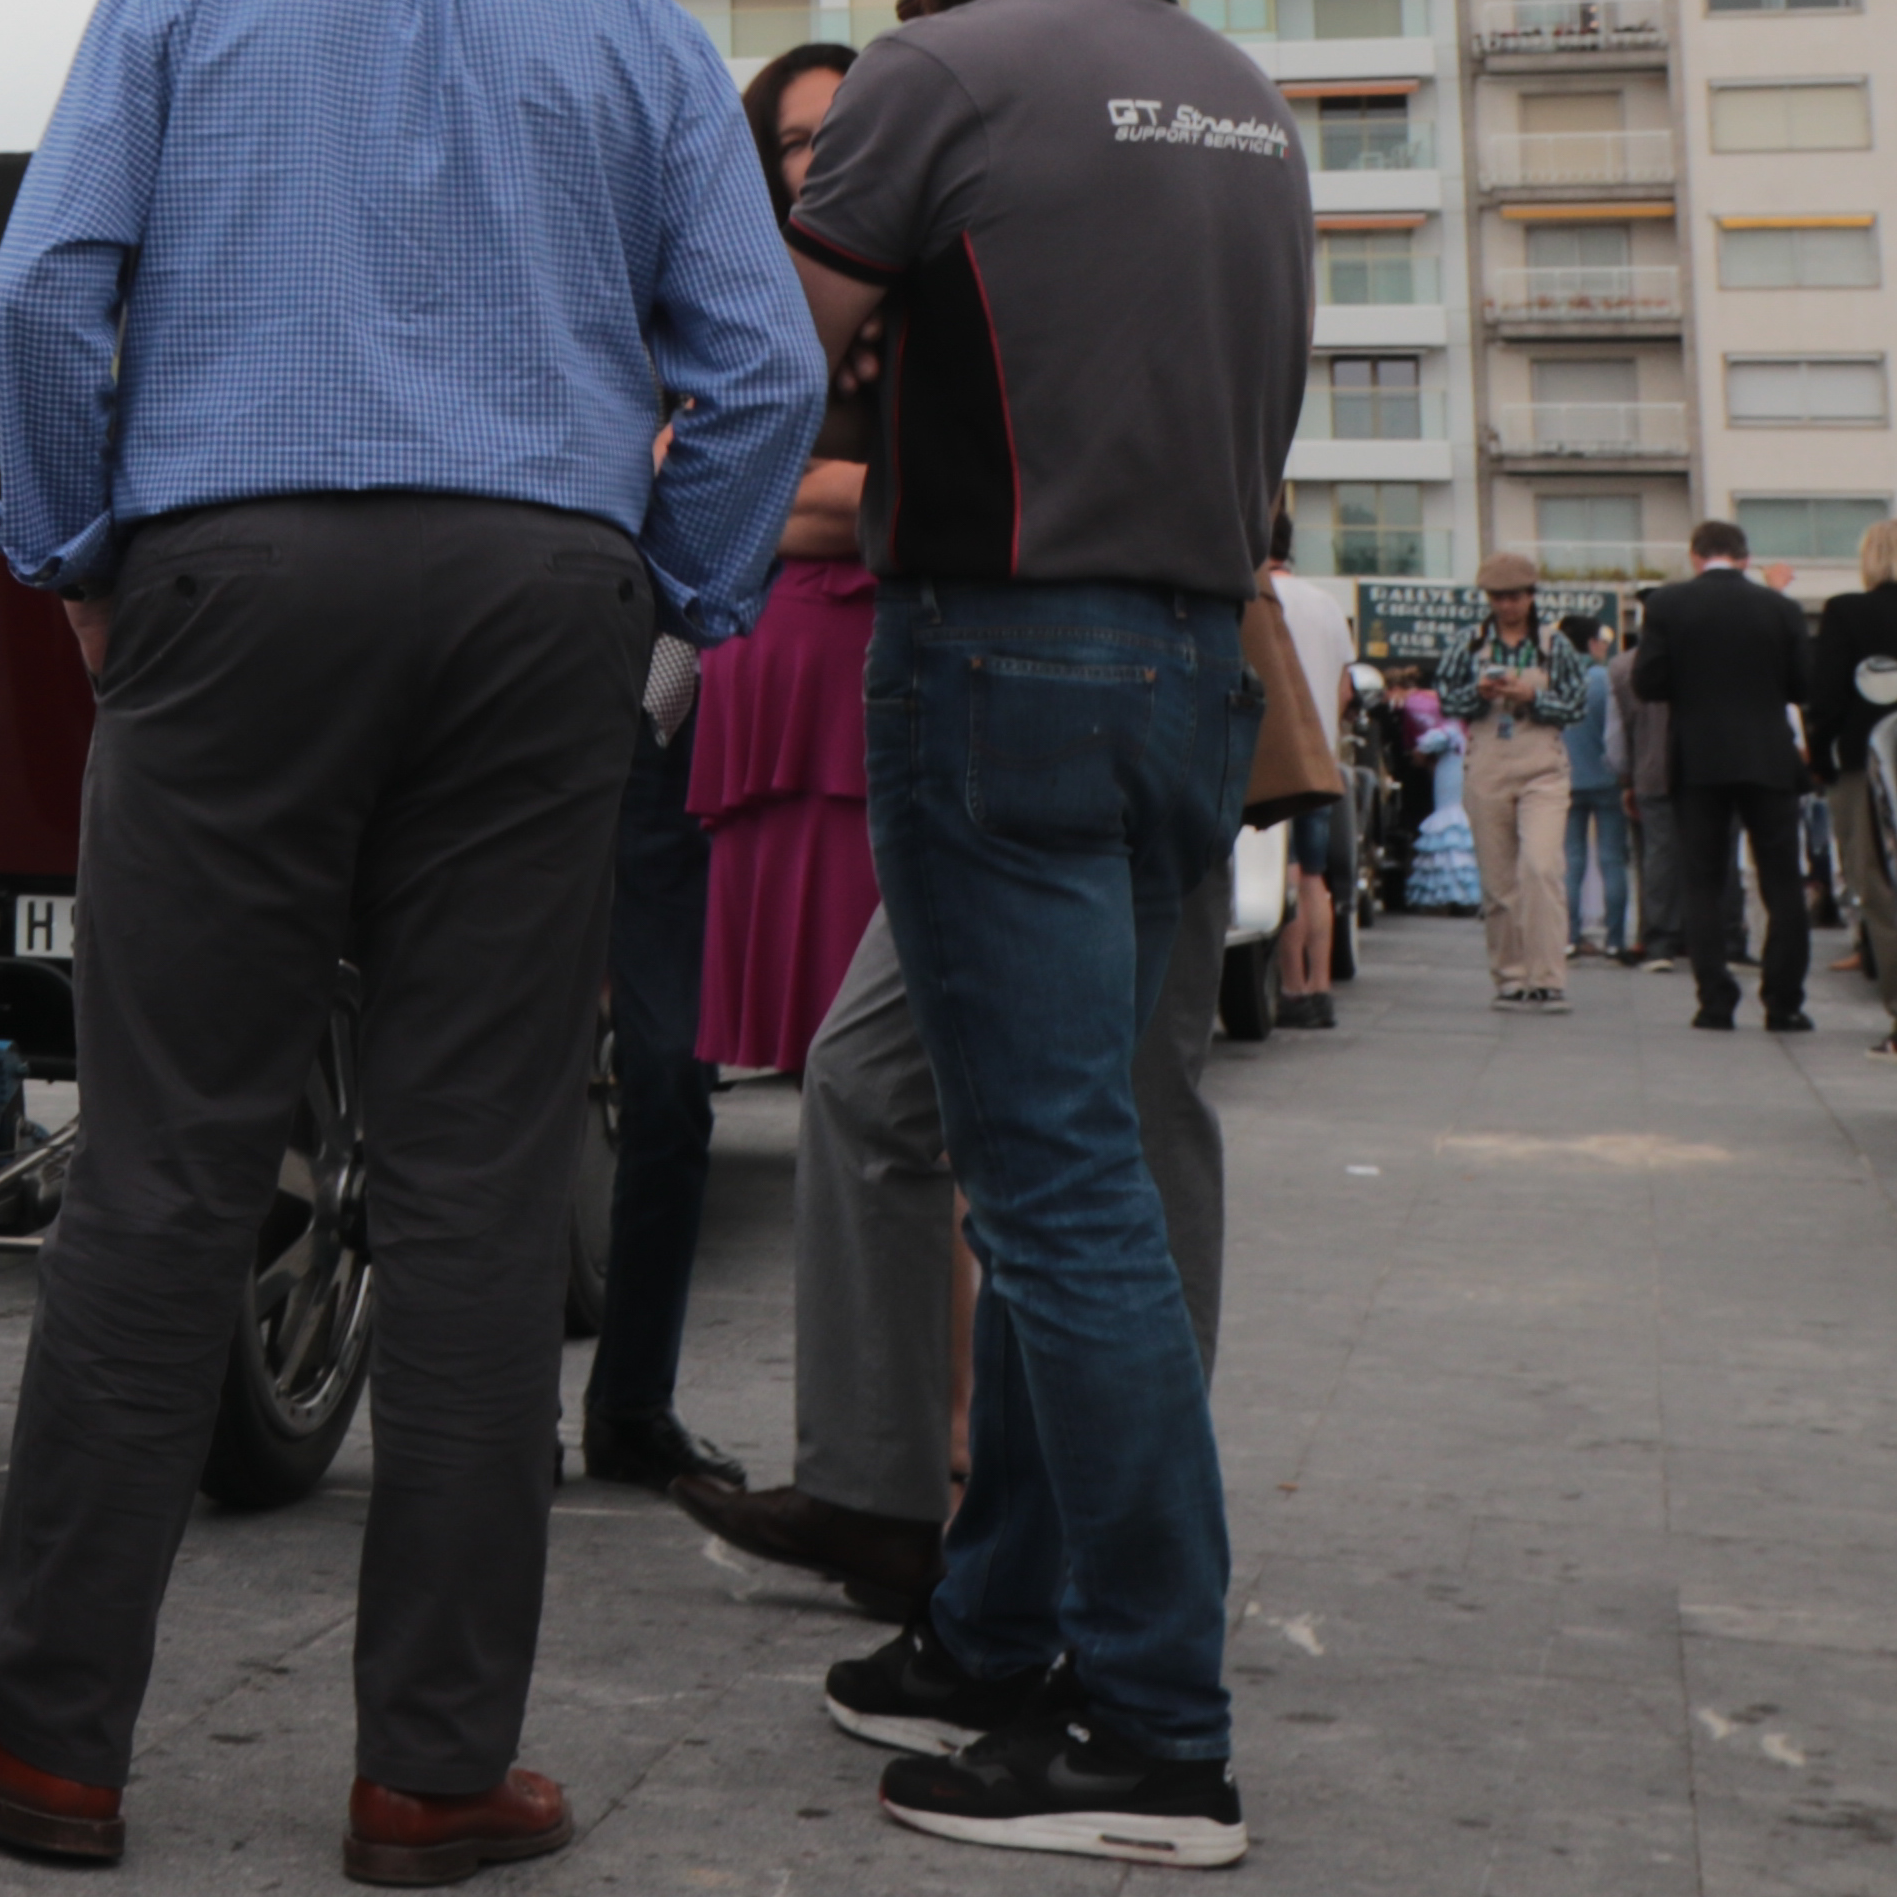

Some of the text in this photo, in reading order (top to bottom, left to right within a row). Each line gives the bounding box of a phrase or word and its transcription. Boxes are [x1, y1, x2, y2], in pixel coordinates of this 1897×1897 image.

[1107, 99, 1162, 126] GT
[1115, 125, 1274, 156] SUPPORT SERVICE
[1369, 586, 1455, 603] RALLYE
[1375, 603, 1475, 620] CIRCUITO
